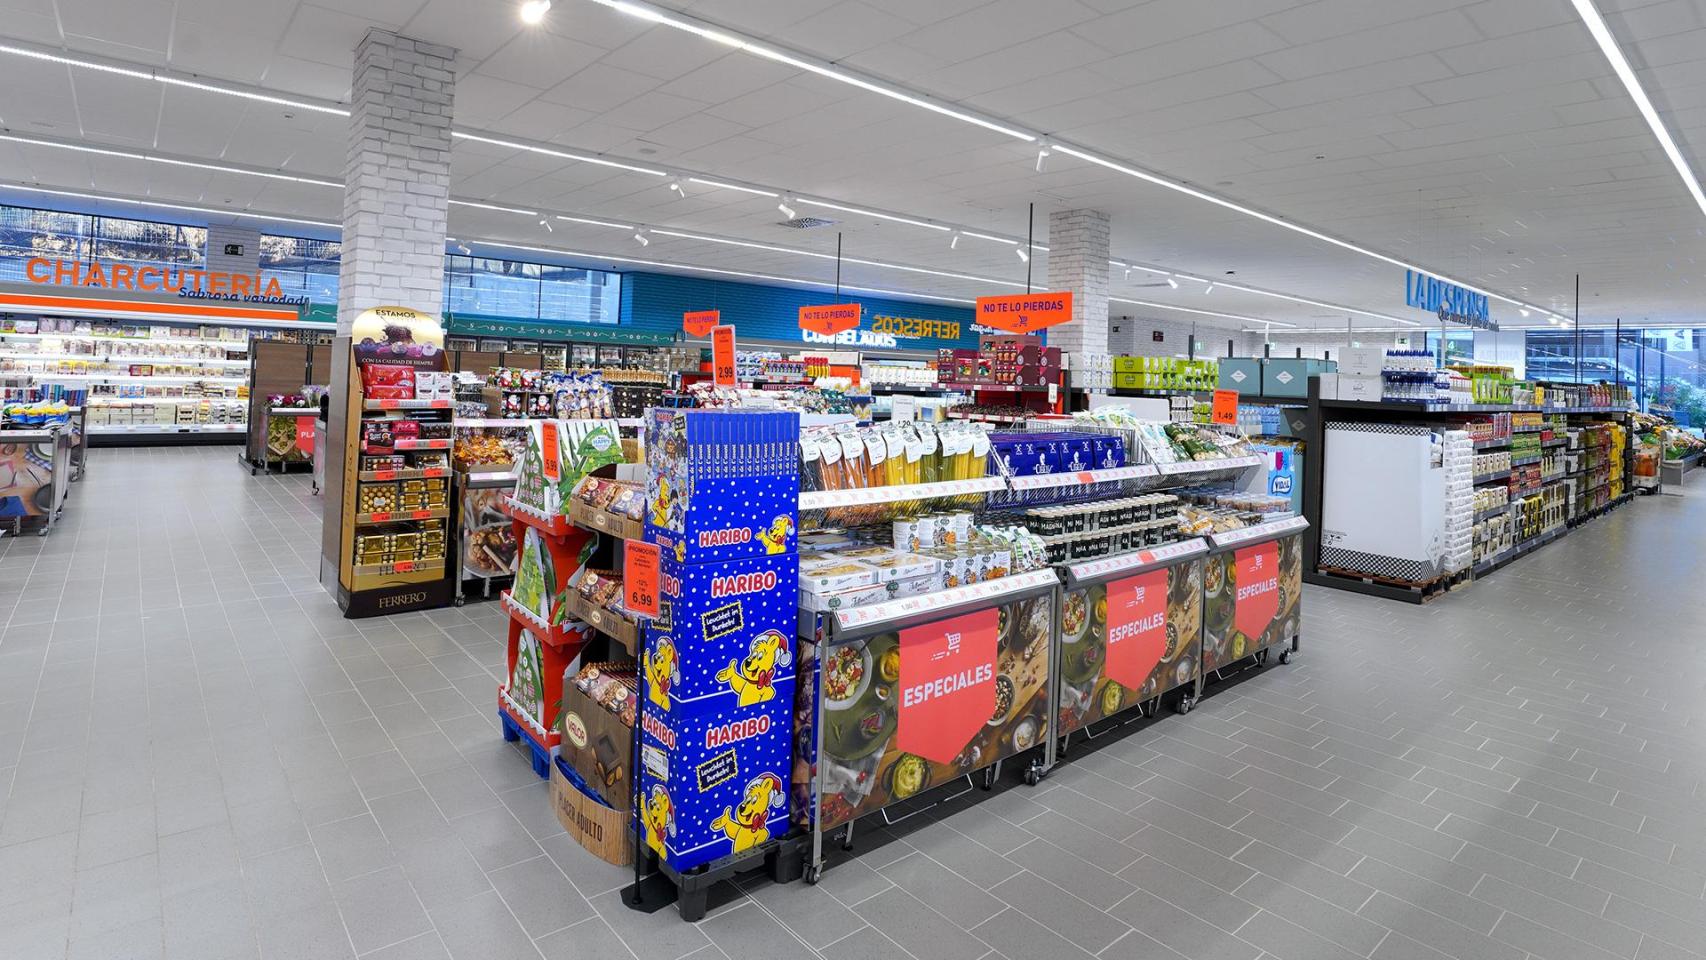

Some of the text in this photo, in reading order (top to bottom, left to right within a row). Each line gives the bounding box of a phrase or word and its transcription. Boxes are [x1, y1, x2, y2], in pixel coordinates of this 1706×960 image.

[26, 257, 283, 297] CHARCUTERÍA
[178, 286, 309, 306] Sabrosa variedad
[984, 300, 1064, 313] NO TE LO PIERDAS
[376, 310, 416, 318] ESTAMOS
[821, 311, 829, 319] LO
[830, 309, 855, 318] PIERDAS
[699, 527, 752, 548] HARIBO
[711, 571, 776, 599] HARIBO
[1237, 577, 1278, 601] ESPECIALES
[379, 591, 427, 608] FERRERO
[1109, 612, 1164, 644] ESPECIALES
[903, 663, 993, 708] ESPECIALES
[567, 722, 586, 744] VALOR
[706, 715, 770, 749] HARIBO
[577, 811, 603, 842] ADULTO
